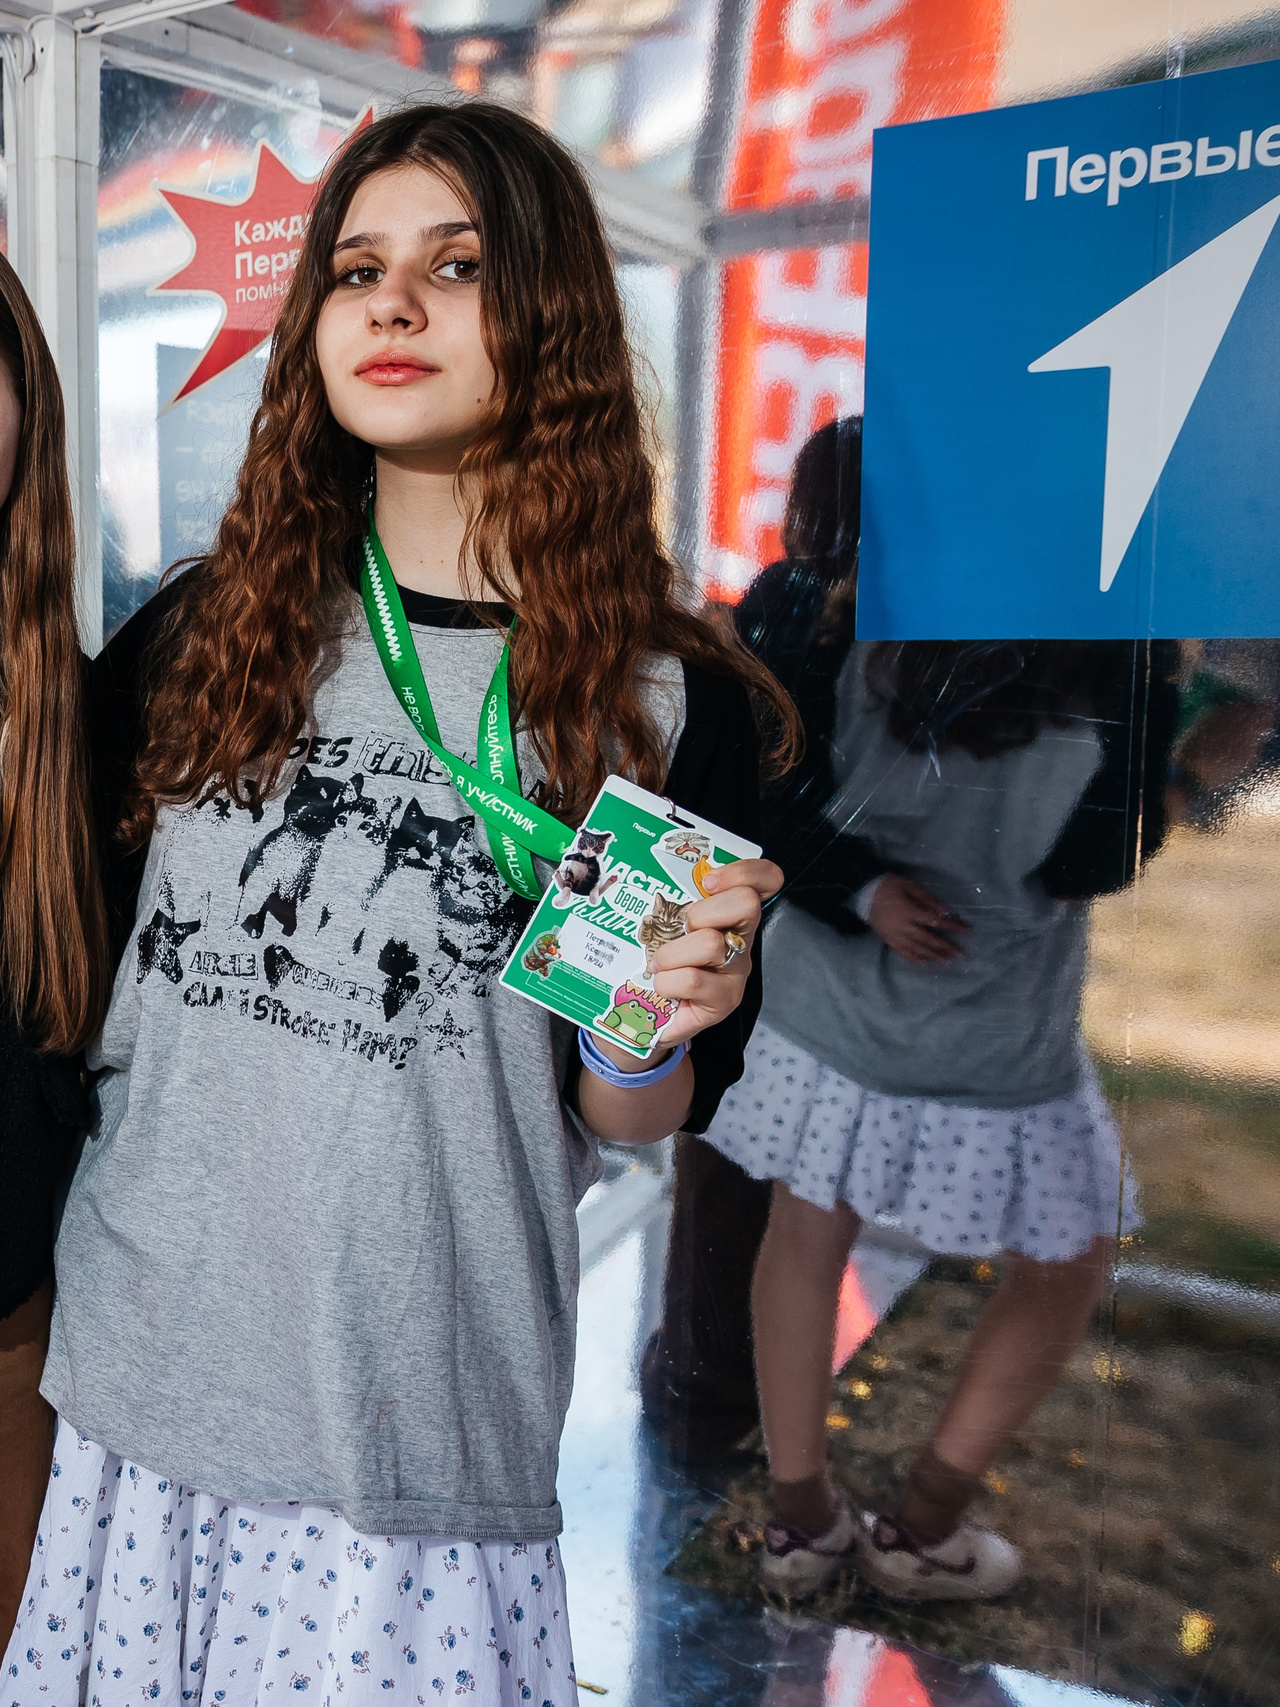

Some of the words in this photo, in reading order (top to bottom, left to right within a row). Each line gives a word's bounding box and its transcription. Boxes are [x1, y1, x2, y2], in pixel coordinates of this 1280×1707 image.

[1025, 124, 1280, 207] Первые
[234, 214, 311, 247] Кажд
[236, 281, 291, 304] помн
[484, 694, 505, 785] олнуйтесь
[456, 775, 465, 788] я
[465, 781, 539, 836] участник
[614, 885, 650, 917] берег
